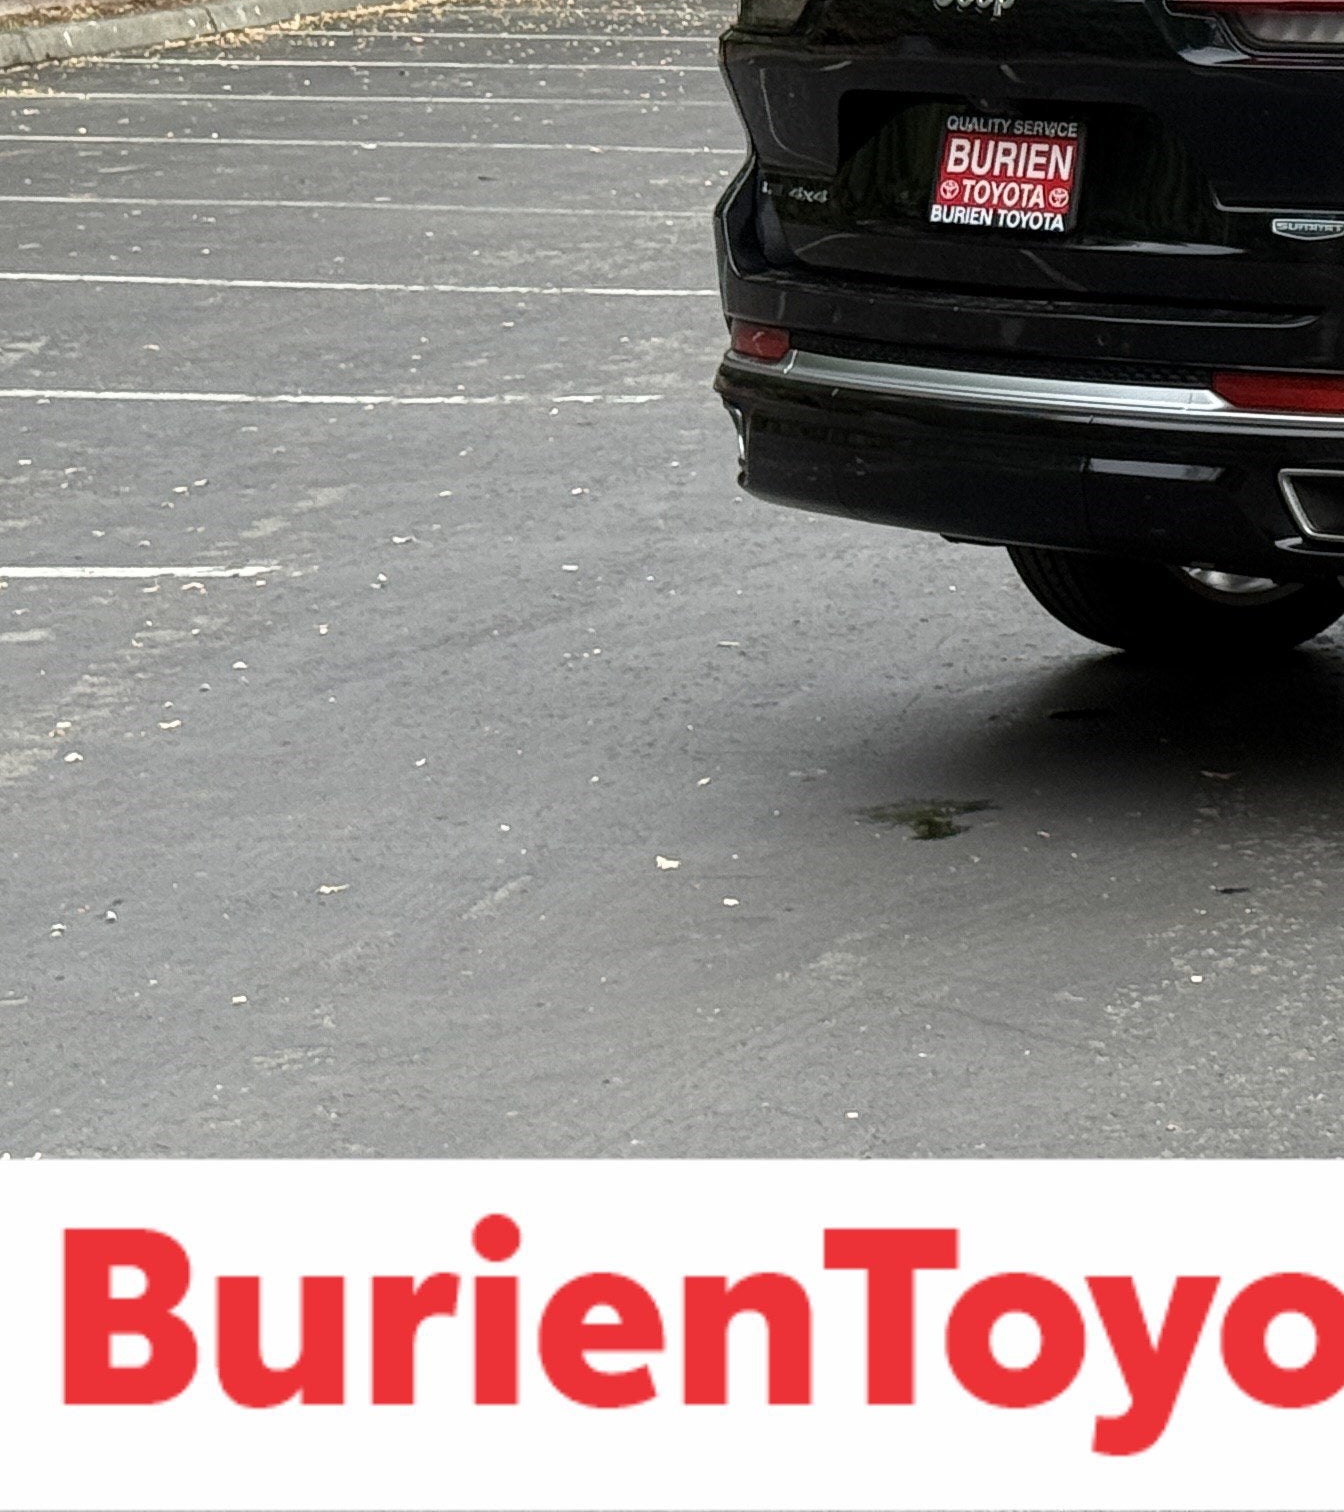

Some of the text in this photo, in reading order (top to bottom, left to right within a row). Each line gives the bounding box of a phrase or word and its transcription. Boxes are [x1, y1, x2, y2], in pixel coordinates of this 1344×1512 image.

[947, 115, 1078, 138] QUALITY SERVICE
[946, 138, 1074, 181] BURIEN
[788, 186, 829, 204] 4x4
[962, 179, 1046, 209] TOYOTA
[930, 204, 1065, 233] BURIEN TOYOTA
